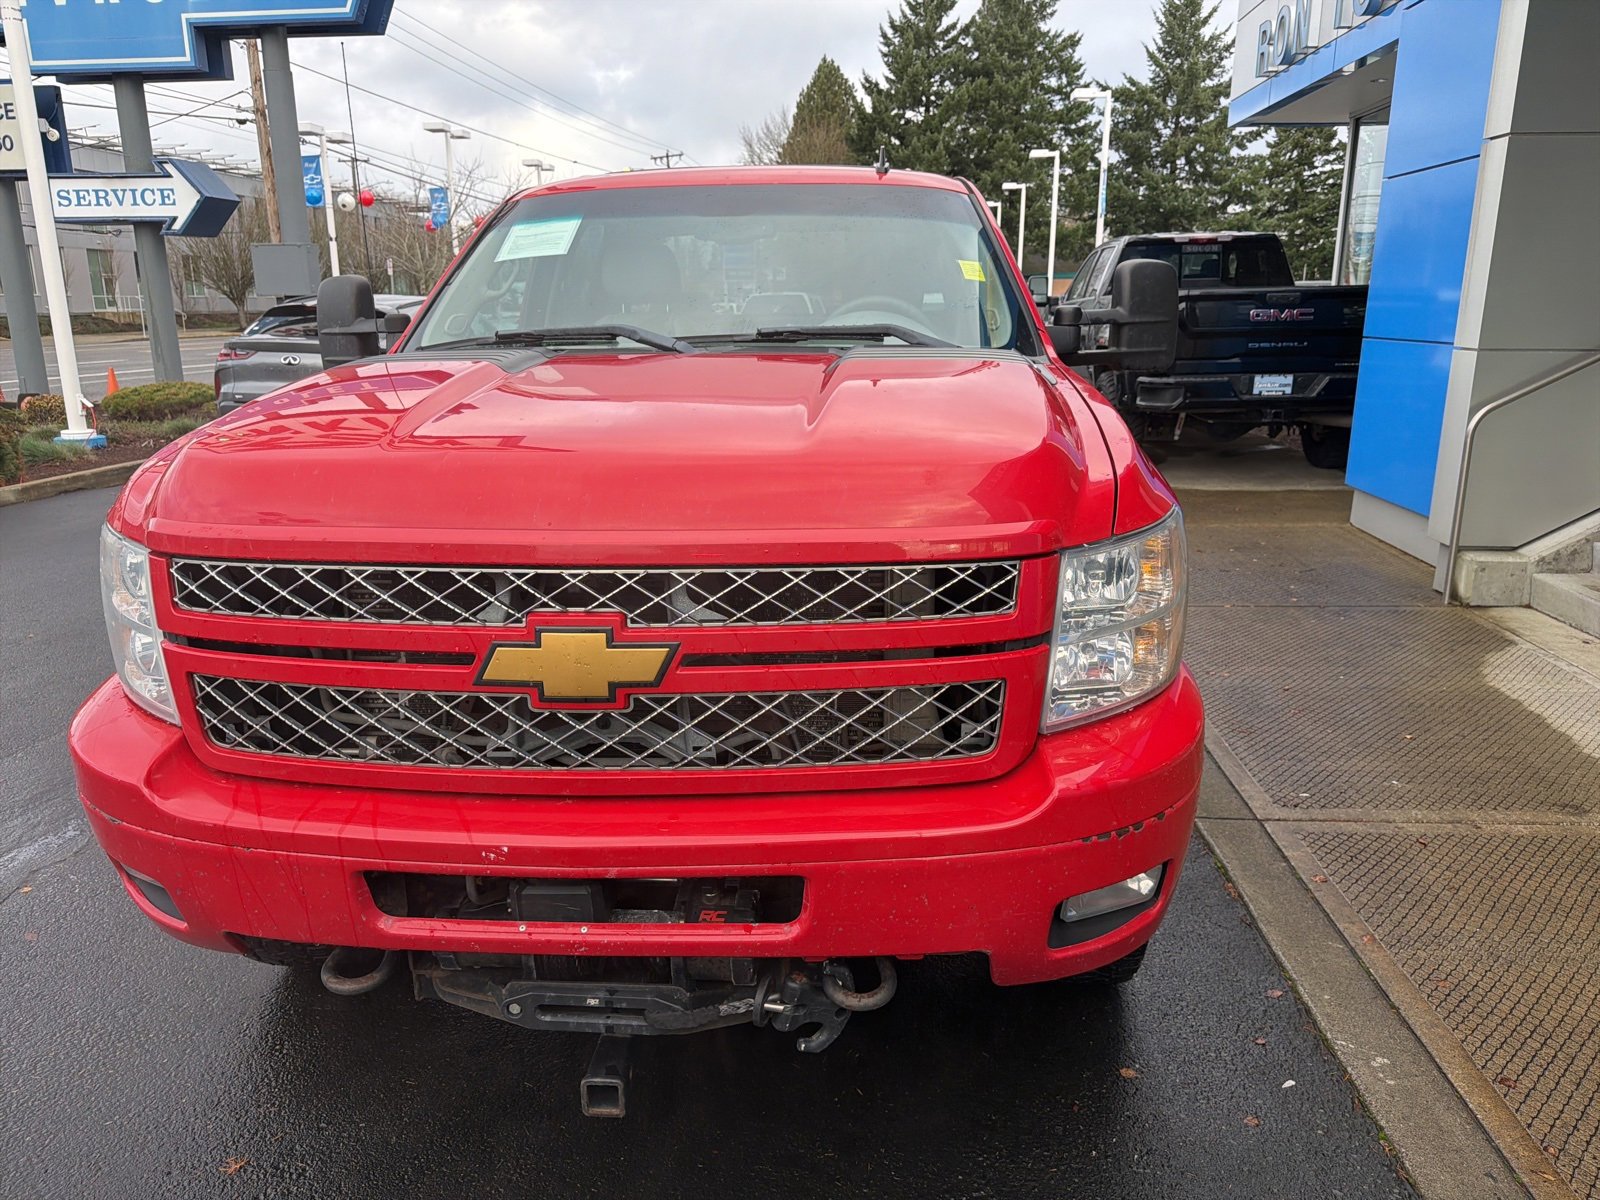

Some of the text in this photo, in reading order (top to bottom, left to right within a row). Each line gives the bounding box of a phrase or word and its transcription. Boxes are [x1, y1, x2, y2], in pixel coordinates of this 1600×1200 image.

[56, 188, 177, 207] SERVICE
[1249, 308, 1315, 322] GMC
[1247, 341, 1309, 349] DENALI
[698, 910, 728, 923] RC
